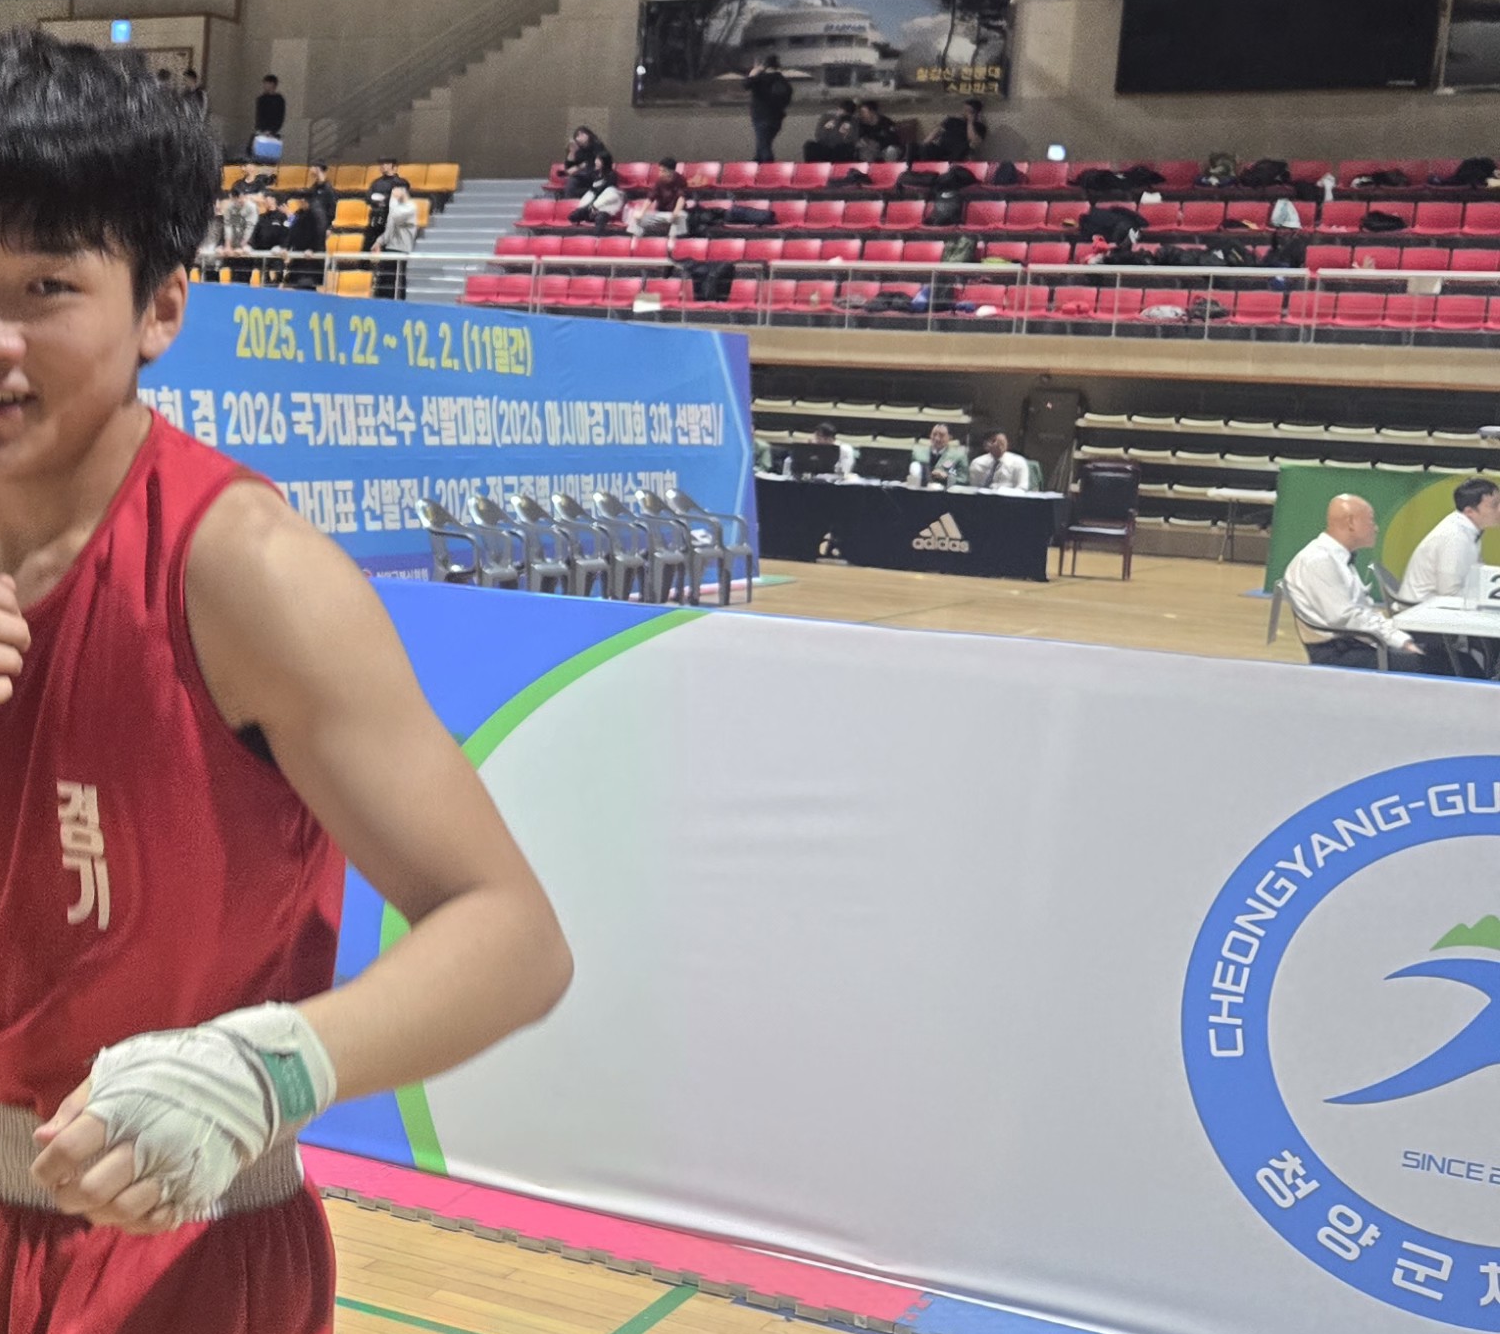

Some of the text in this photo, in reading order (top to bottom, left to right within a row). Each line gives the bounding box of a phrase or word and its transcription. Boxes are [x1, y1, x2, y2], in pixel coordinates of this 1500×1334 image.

[233, 305, 305, 363] 2025.
[309, 312, 346, 365] 11.
[350, 315, 379, 364] 22
[403, 319, 435, 370] 12.
[463, 320, 532, 376] (11일간)
[190, 388, 218, 448] 겸
[222, 392, 287, 446] 2026
[290, 392, 416, 447] 국가대표선수
[544, 400, 648, 447] 아시아경기대회
[650, 403, 673, 445] 3차
[276, 480, 358, 534] 가대표
[912, 535, 970, 554] adidas
[1402, 1150, 1484, 1182] SINCE
